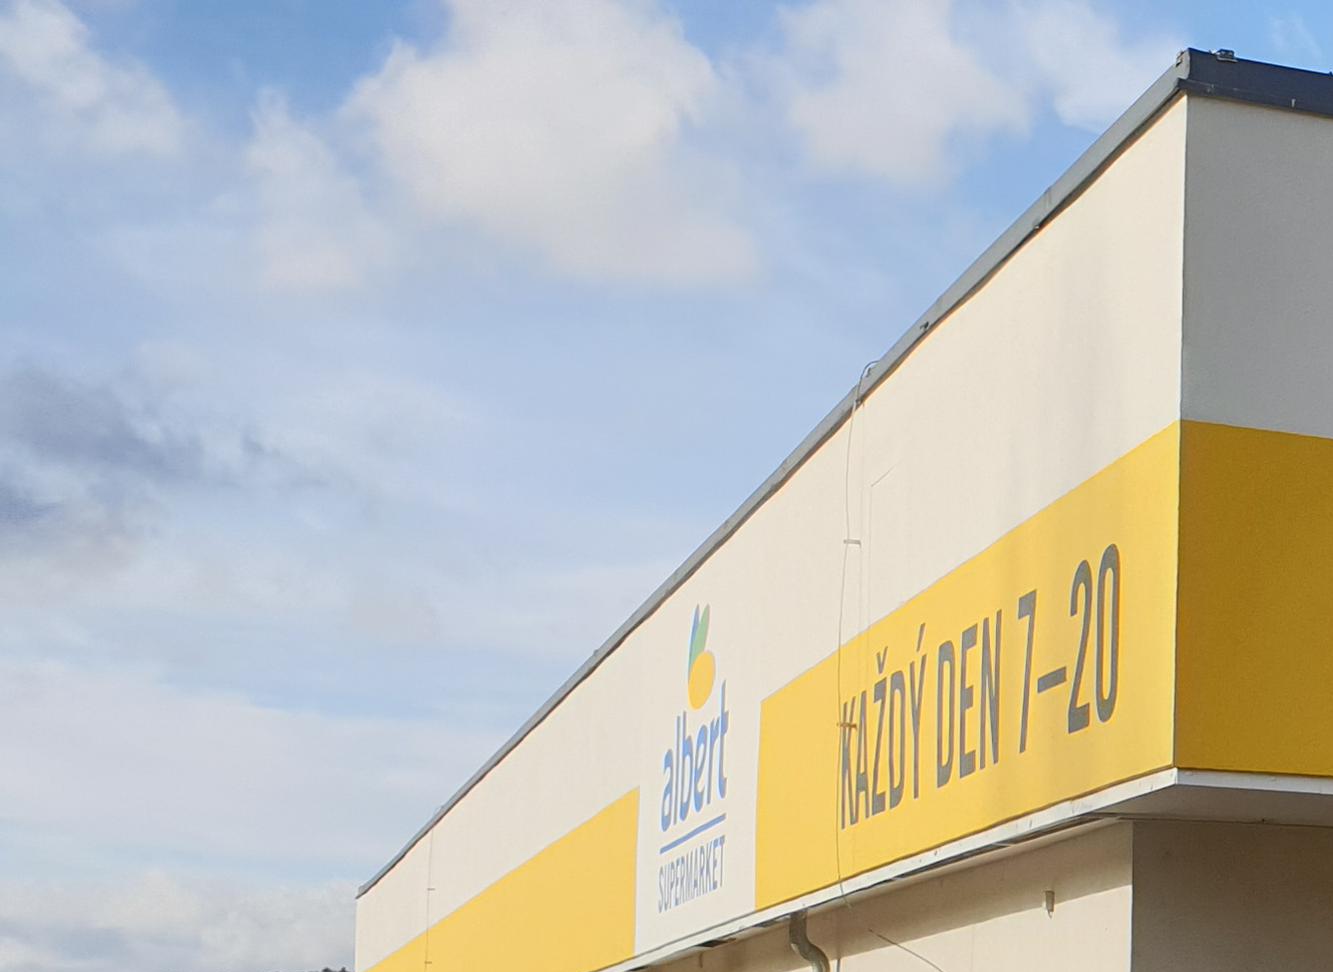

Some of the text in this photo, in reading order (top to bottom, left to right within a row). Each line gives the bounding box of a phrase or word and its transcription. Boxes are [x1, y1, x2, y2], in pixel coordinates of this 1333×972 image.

[660, 679, 729, 832] albert
[840, 622, 928, 830] KAŽDÝ
[936, 609, 1003, 788] DEN
[657, 834, 726, 914] SUPERMARKET
